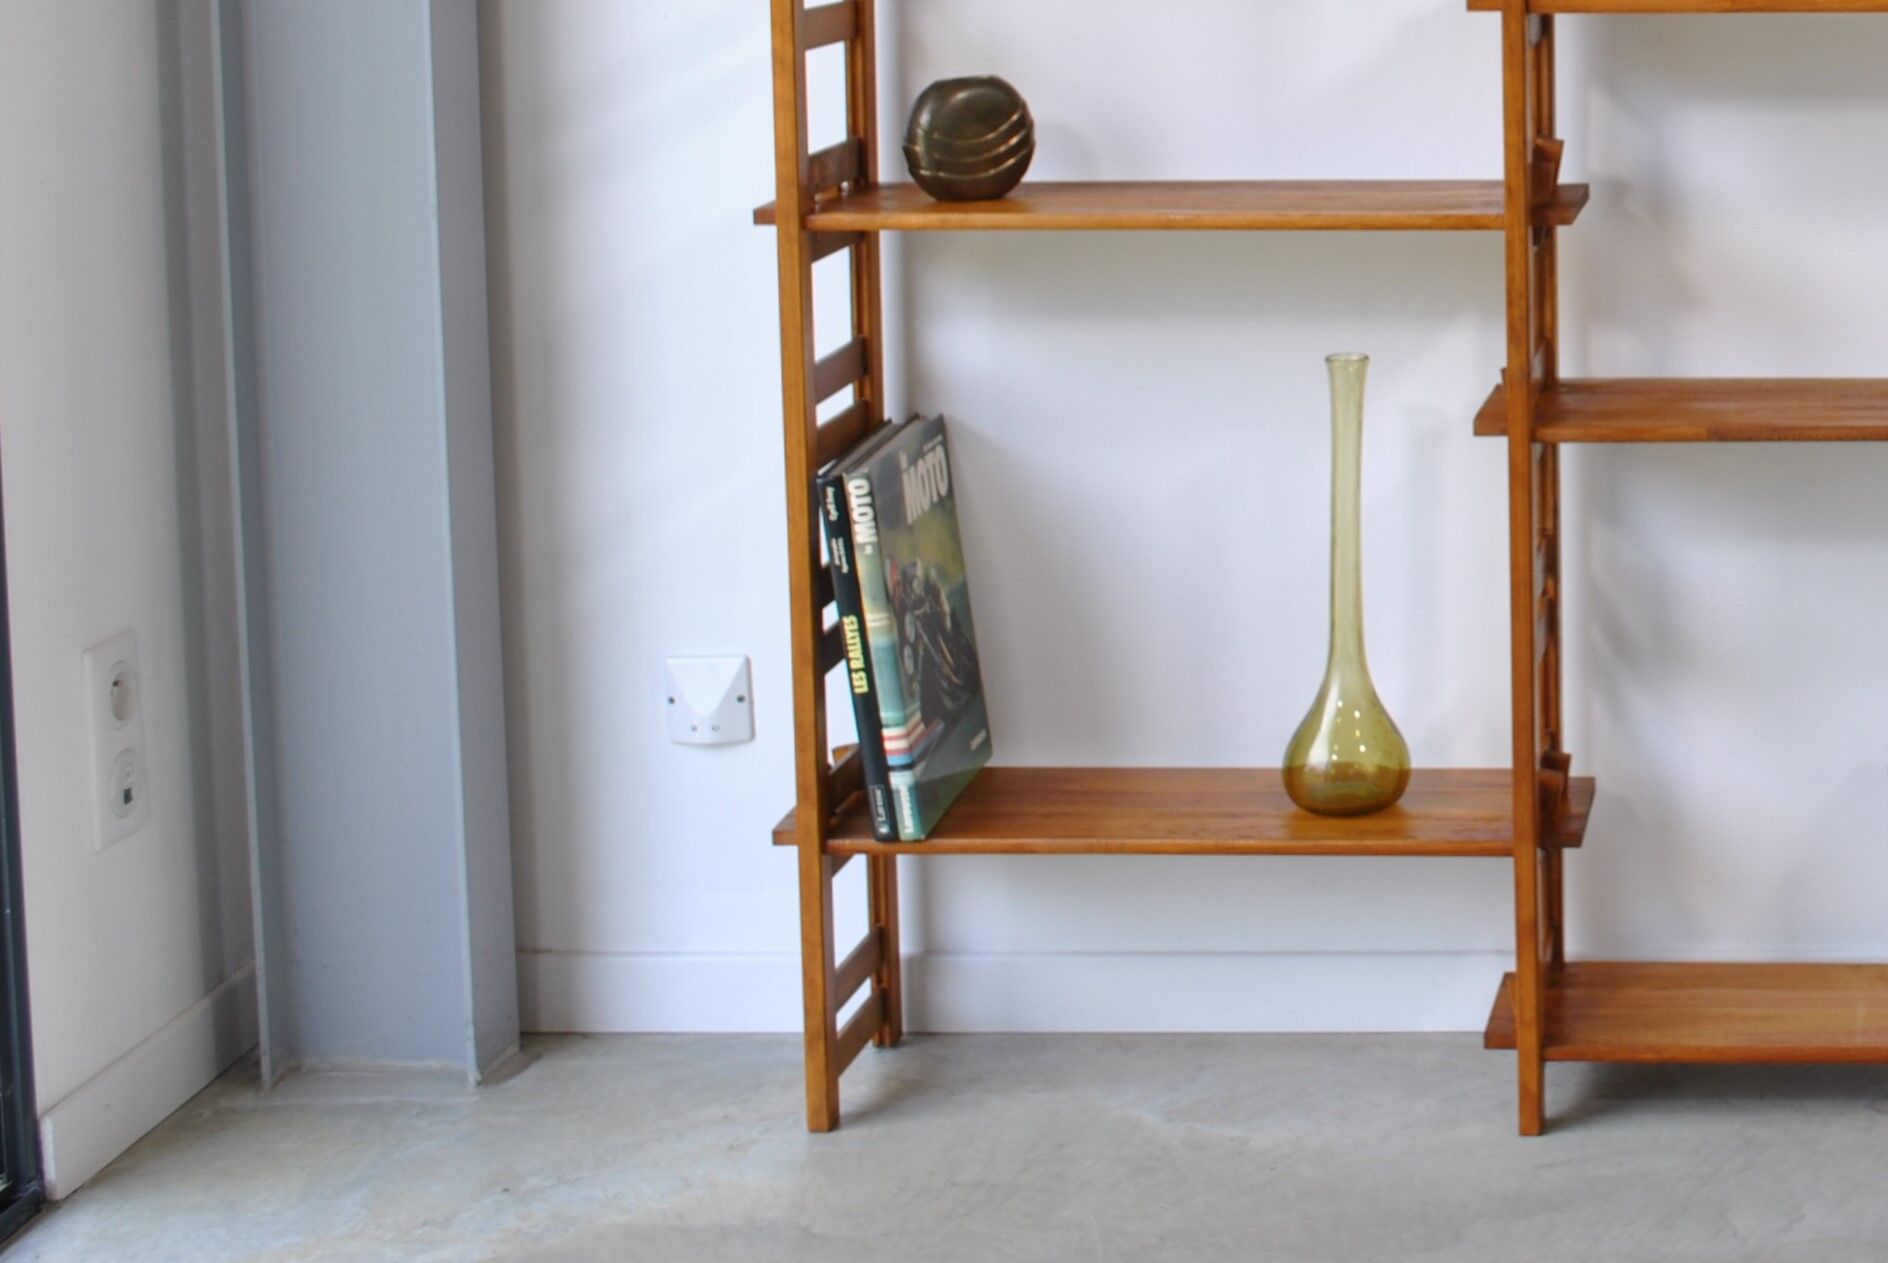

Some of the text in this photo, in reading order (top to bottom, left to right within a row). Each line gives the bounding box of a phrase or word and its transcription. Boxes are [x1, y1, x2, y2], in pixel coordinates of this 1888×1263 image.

[847, 478, 878, 543] MOTO
[902, 444, 948, 526] MOTO
[842, 614, 869, 694] LES RALLYES
